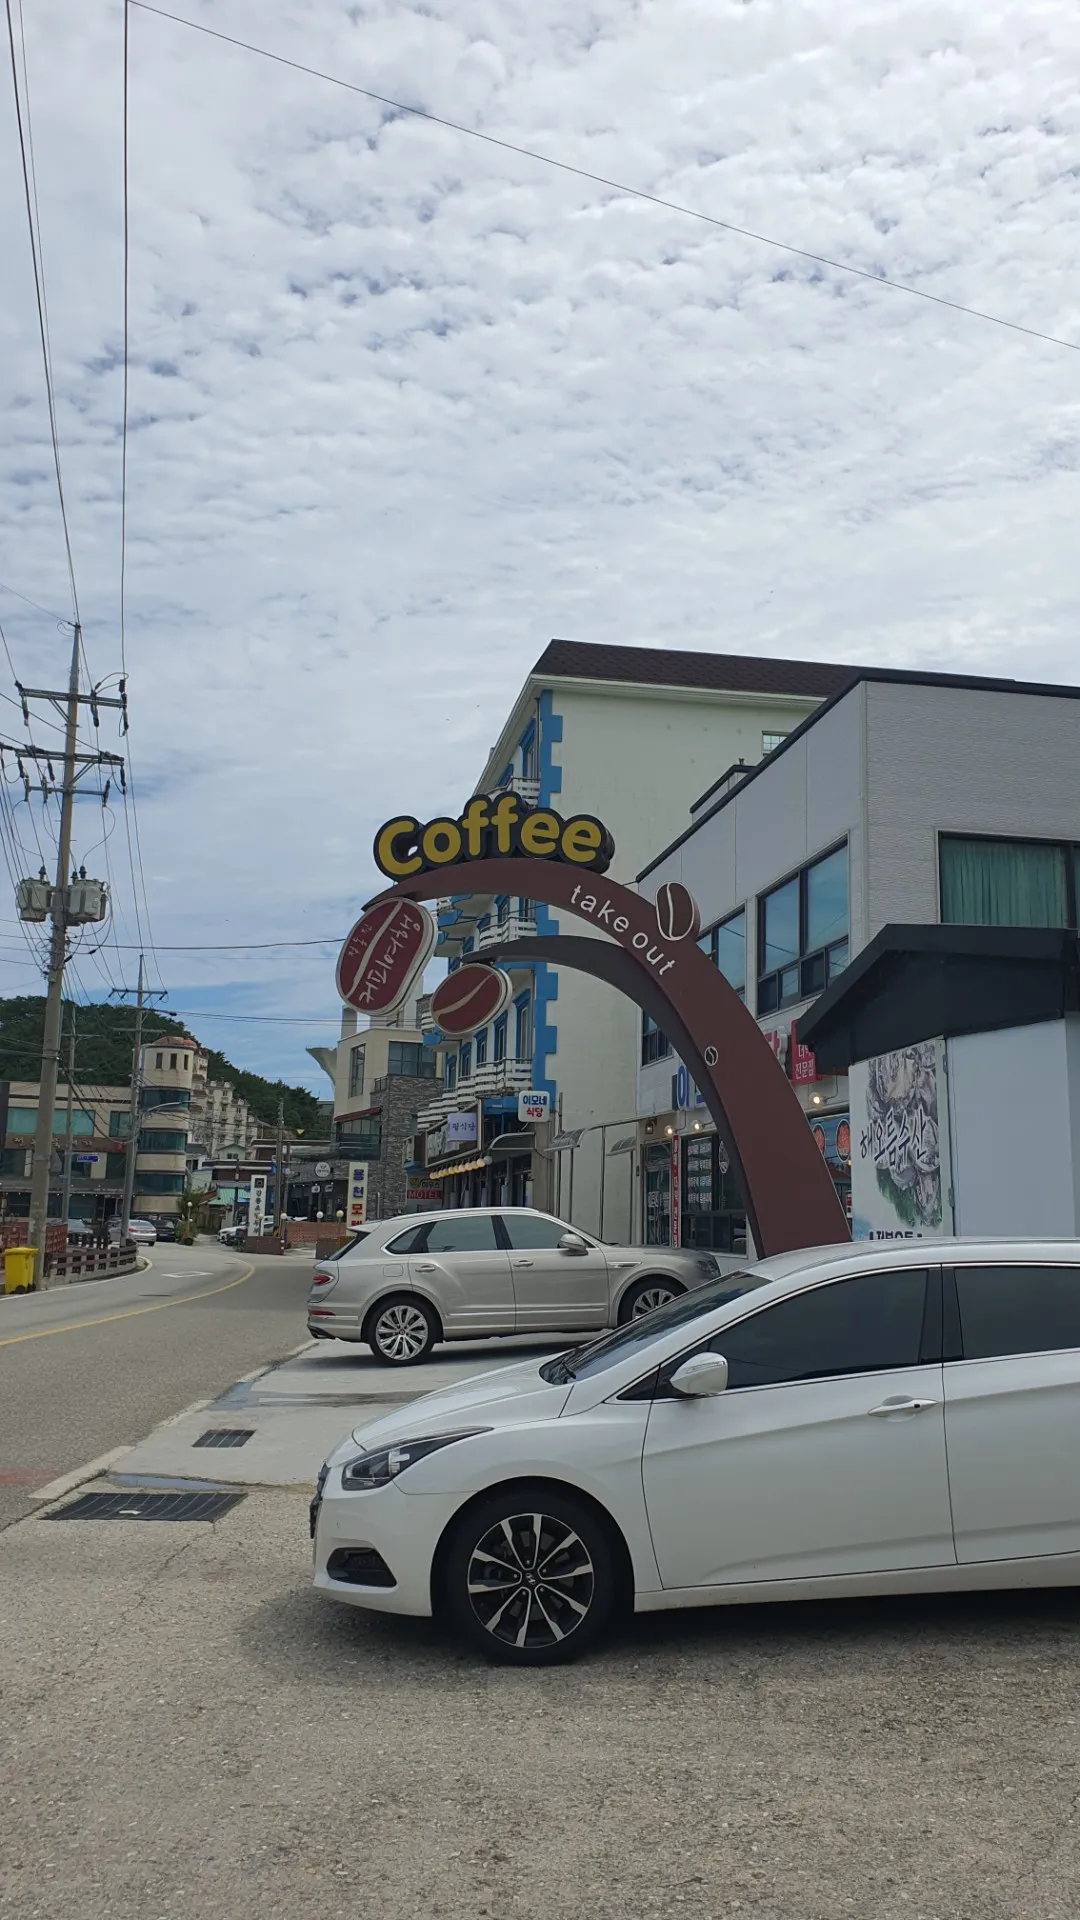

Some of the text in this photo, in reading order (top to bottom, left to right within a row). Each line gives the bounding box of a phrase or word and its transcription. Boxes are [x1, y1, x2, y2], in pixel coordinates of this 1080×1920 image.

[377, 795, 602, 876] Coffee
[570, 884, 678, 977] take out
[358, 913, 421, 1004] 커피여행
[794, 1058, 814, 1080] 전문점
[522, 1095, 548, 1106] 이모네
[526, 1106, 544, 1118] 식당
[408, 1190, 441, 1199] MOTEL
